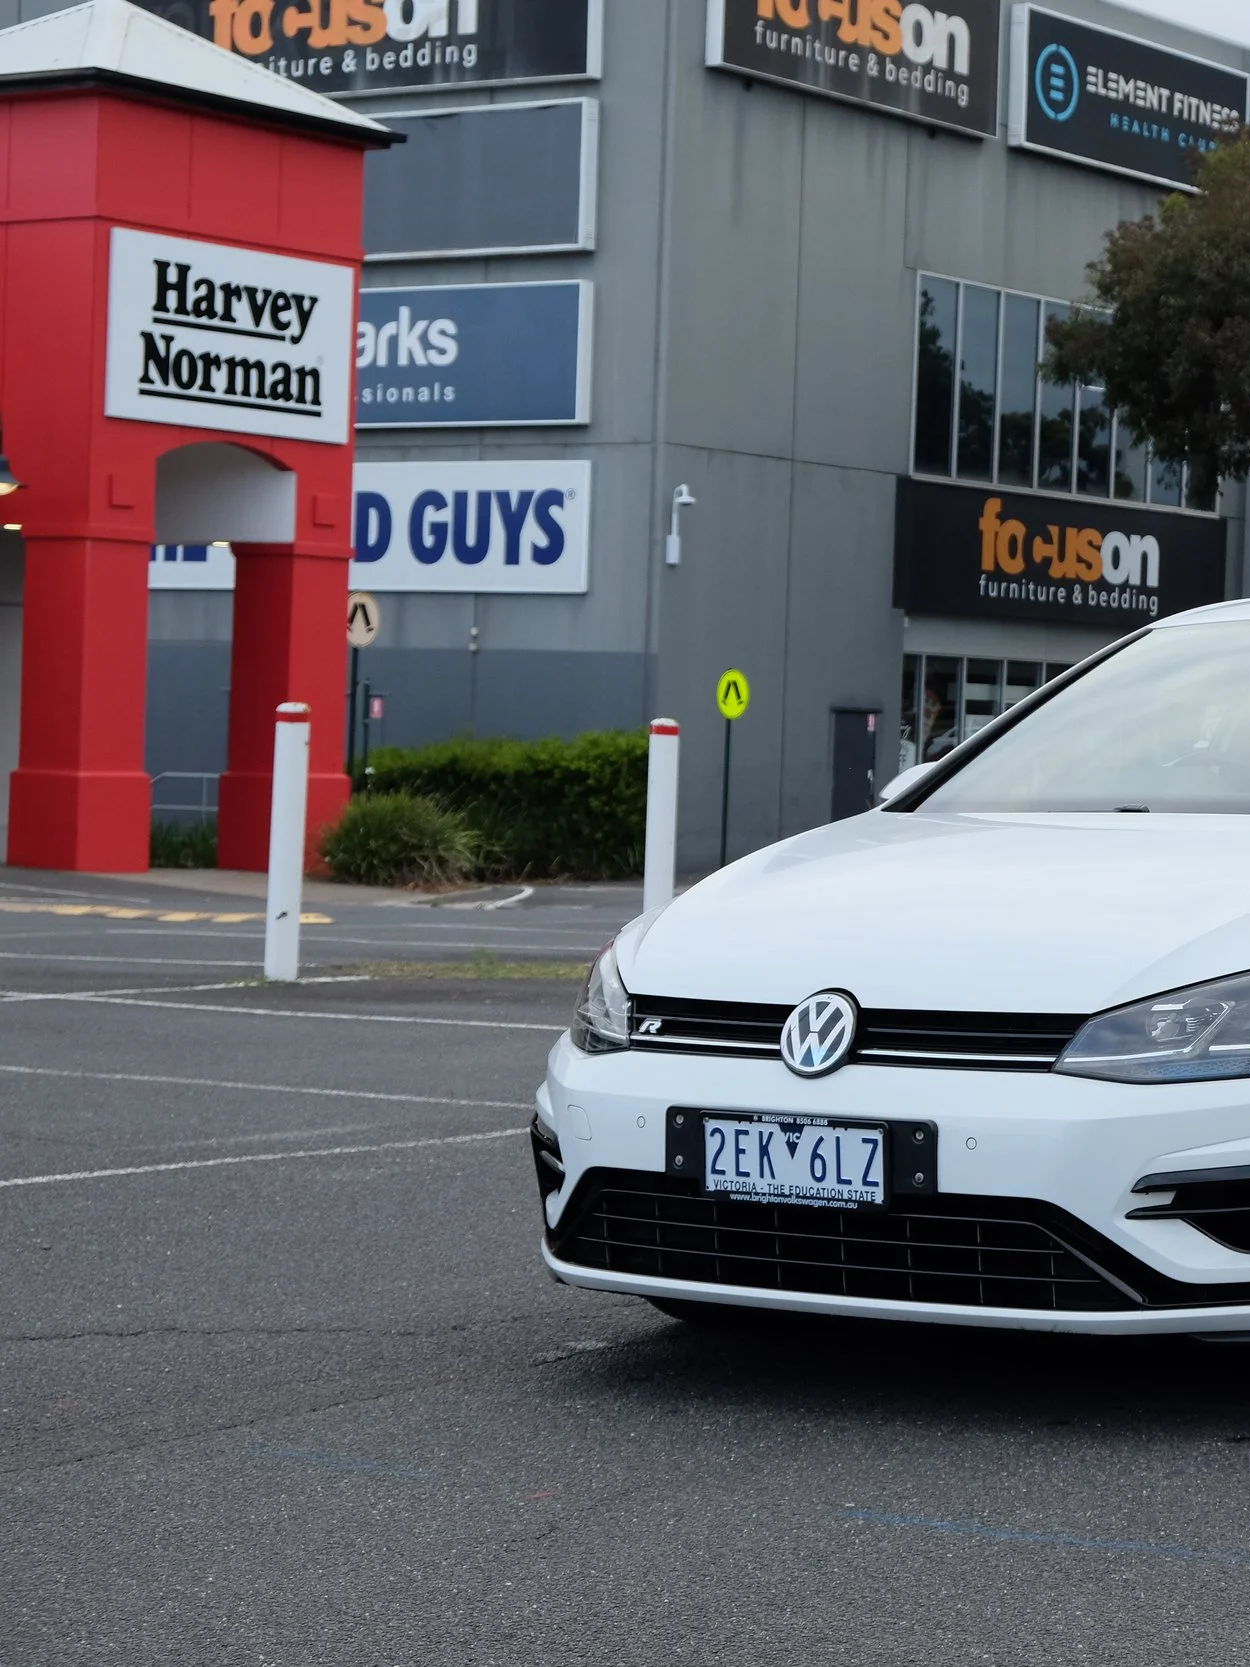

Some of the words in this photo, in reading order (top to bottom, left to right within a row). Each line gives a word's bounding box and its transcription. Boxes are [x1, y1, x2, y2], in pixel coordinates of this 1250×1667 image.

[342, 50, 357, 73] &
[366, 42, 478, 70] bedding
[754, 20, 860, 72] furniture
[866, 53, 880, 77] &
[885, 57, 969, 107] bedding
[1086, 65, 1171, 114] ELEMENT
[1109, 112, 1170, 142] HEALTH
[153, 258, 318, 345] Harvey
[356, 305, 459, 368] arks
[139, 331, 321, 406] Norman
[355, 382, 456, 404] sionals
[979, 574, 1066, 604] furniture
[1072, 584, 1083, 605] &
[1089, 585, 1159, 617] bedding
[638, 1017, 662, 1034] R
[761, 1114, 794, 1125] BRIGHTON
[784, 1131, 801, 1143] VIC
[709, 1126, 776, 1180] 2EK
[810, 1135, 880, 1188] 6LZ
[713, 1179, 758, 1194] VICTORIA
[767, 1183, 786, 1196] THE
[788, 1185, 844, 1200] EDUCATION
[847, 1189, 877, 1202] STATE
